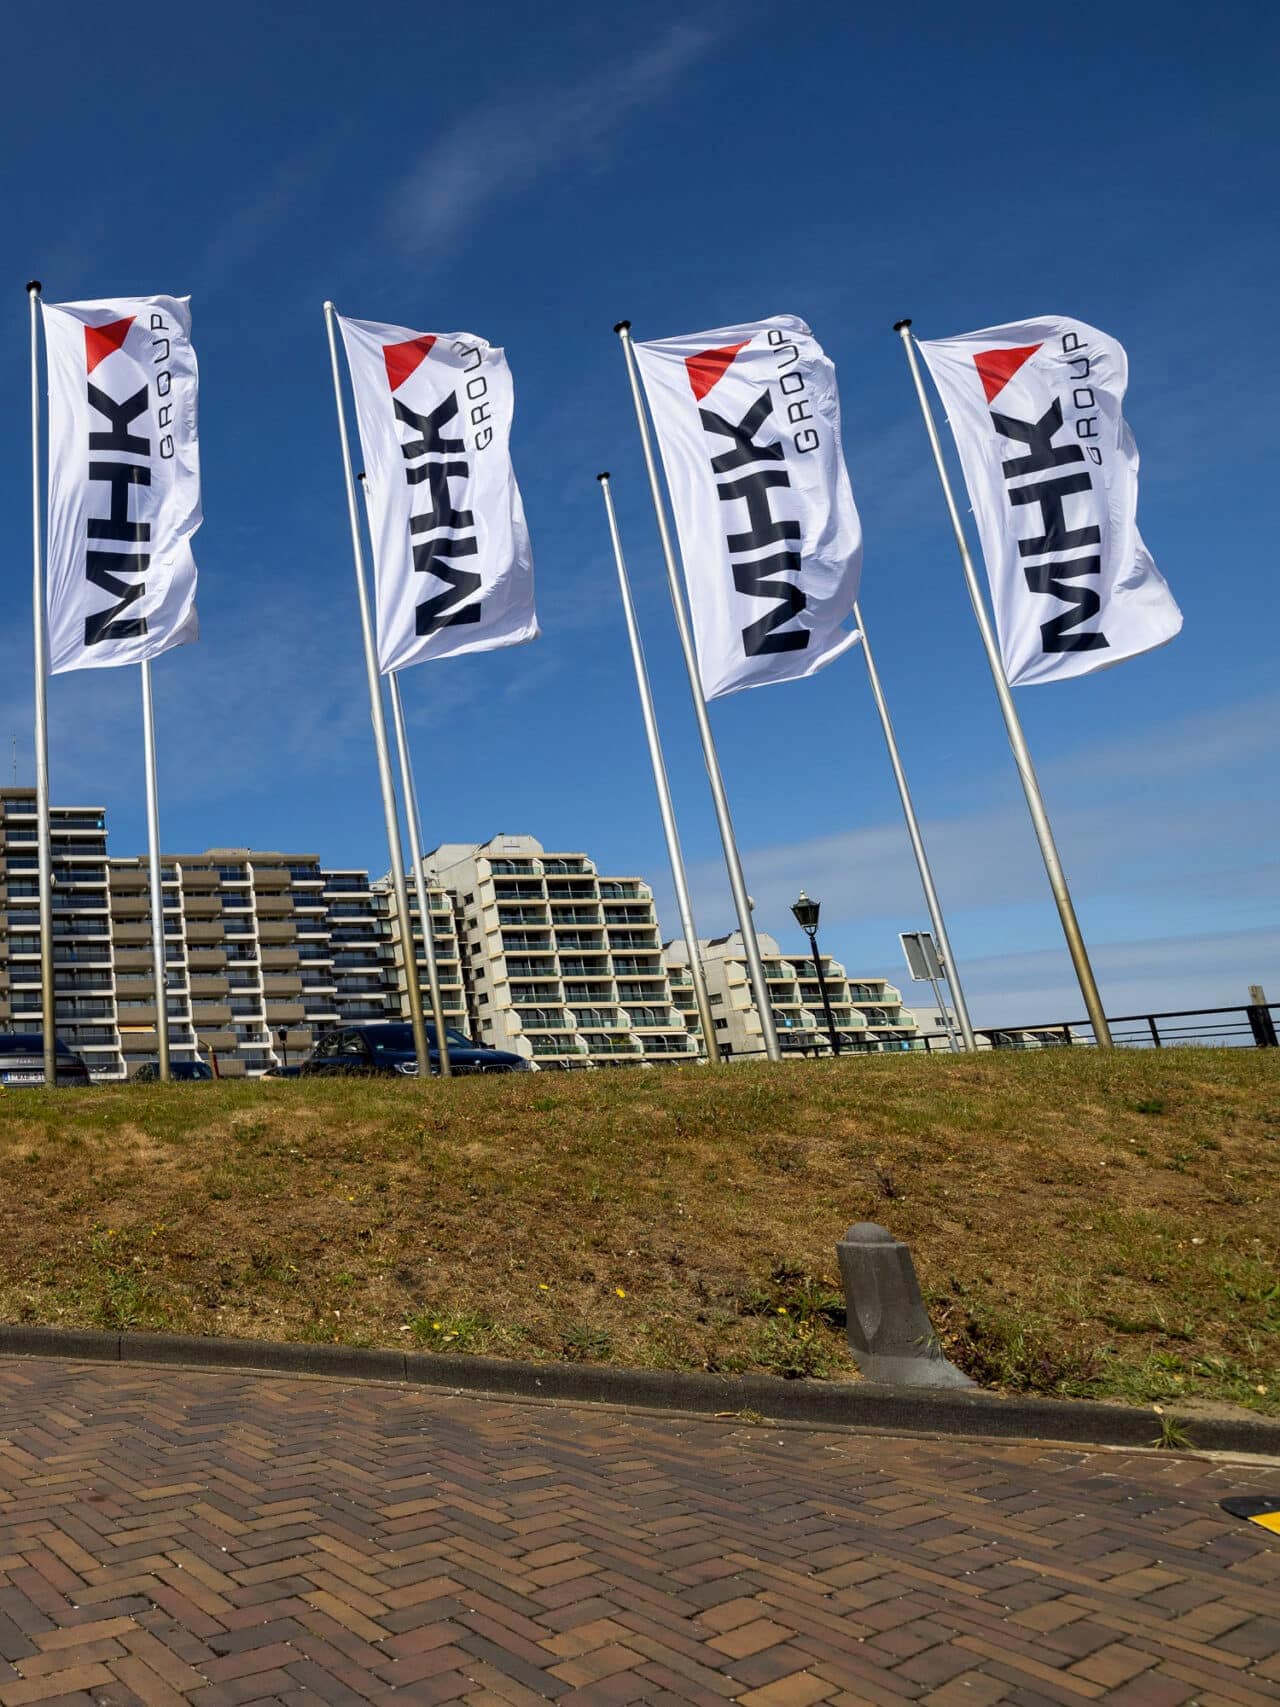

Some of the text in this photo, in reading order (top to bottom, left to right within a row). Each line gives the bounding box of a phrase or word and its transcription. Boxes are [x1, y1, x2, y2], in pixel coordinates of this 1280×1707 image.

[151, 313, 175, 459] GROUP
[768, 330, 819, 454] GROUP
[1062, 332, 1102, 465] GROUP
[85, 382, 151, 645] MHK
[393, 391, 481, 636] MHK
[699, 389, 810, 656] MHK
[990, 397, 1109, 653] MHK
